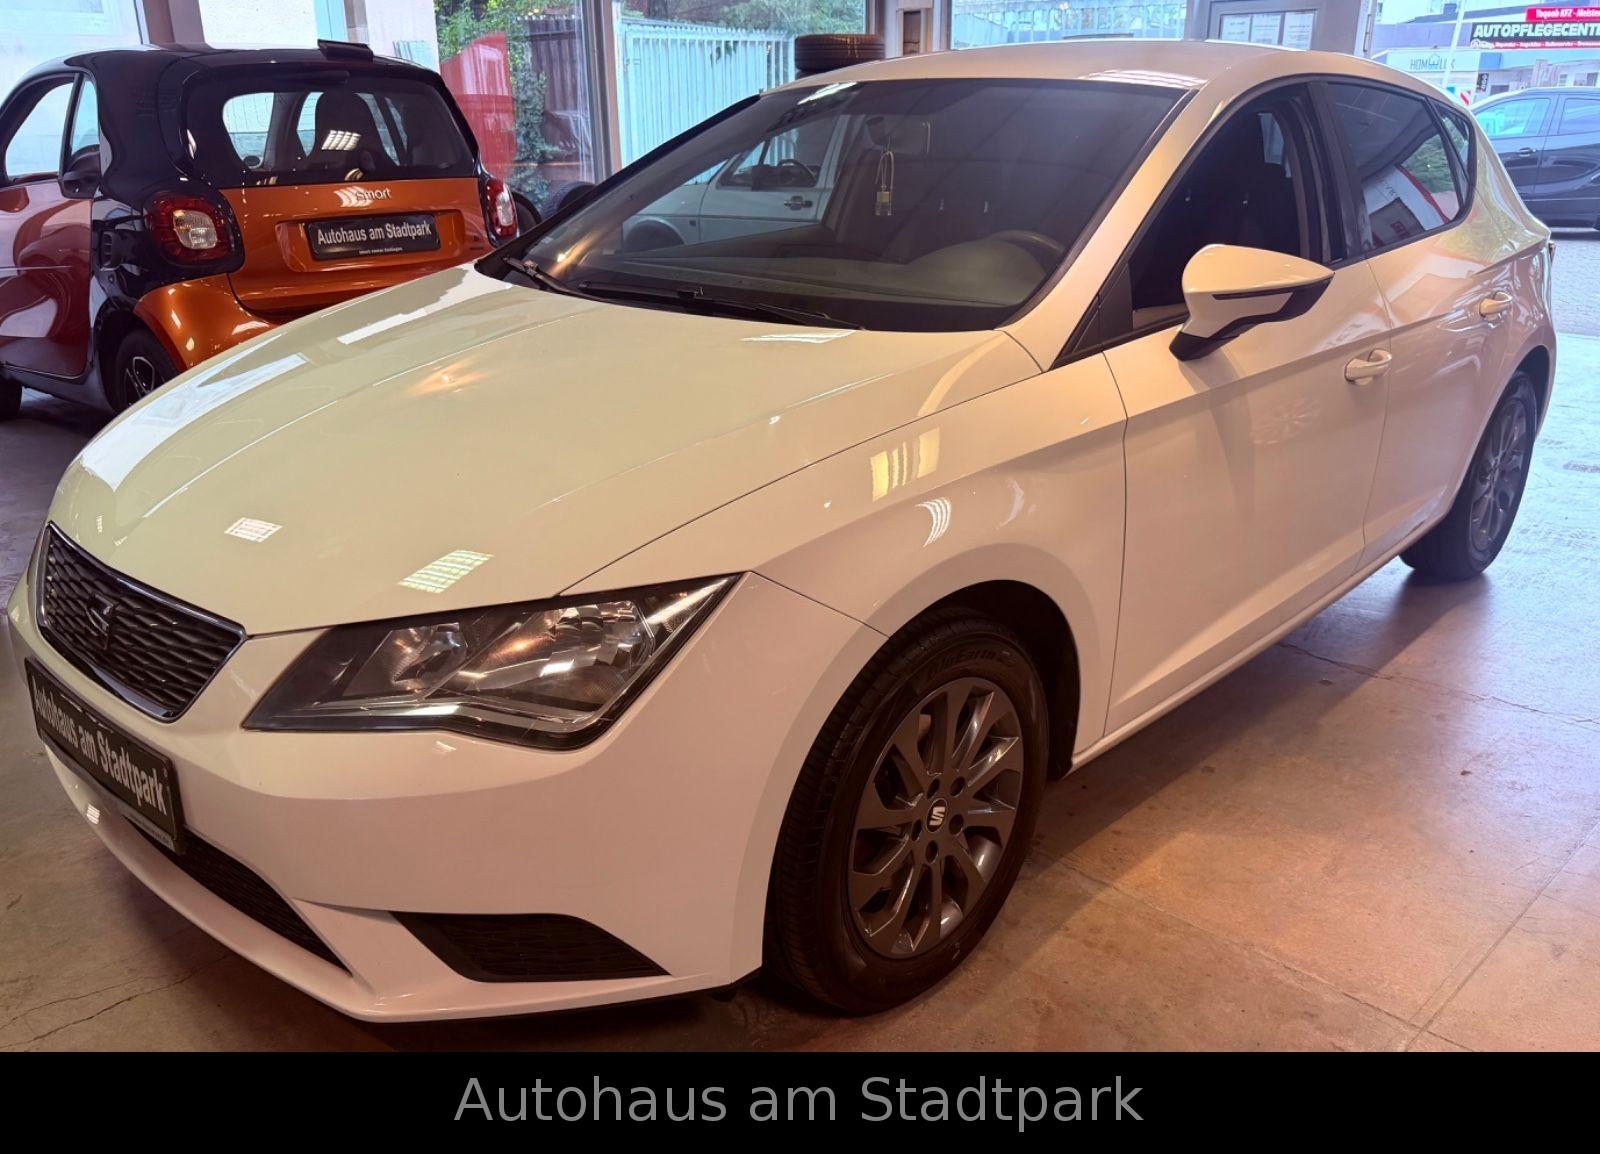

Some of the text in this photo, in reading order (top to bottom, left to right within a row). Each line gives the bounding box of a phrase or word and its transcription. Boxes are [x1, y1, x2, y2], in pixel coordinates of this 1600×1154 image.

[317, 220, 432, 245] Autohaus am Stadtpark
[31, 675, 167, 816] Autohaus am Stadtpark
